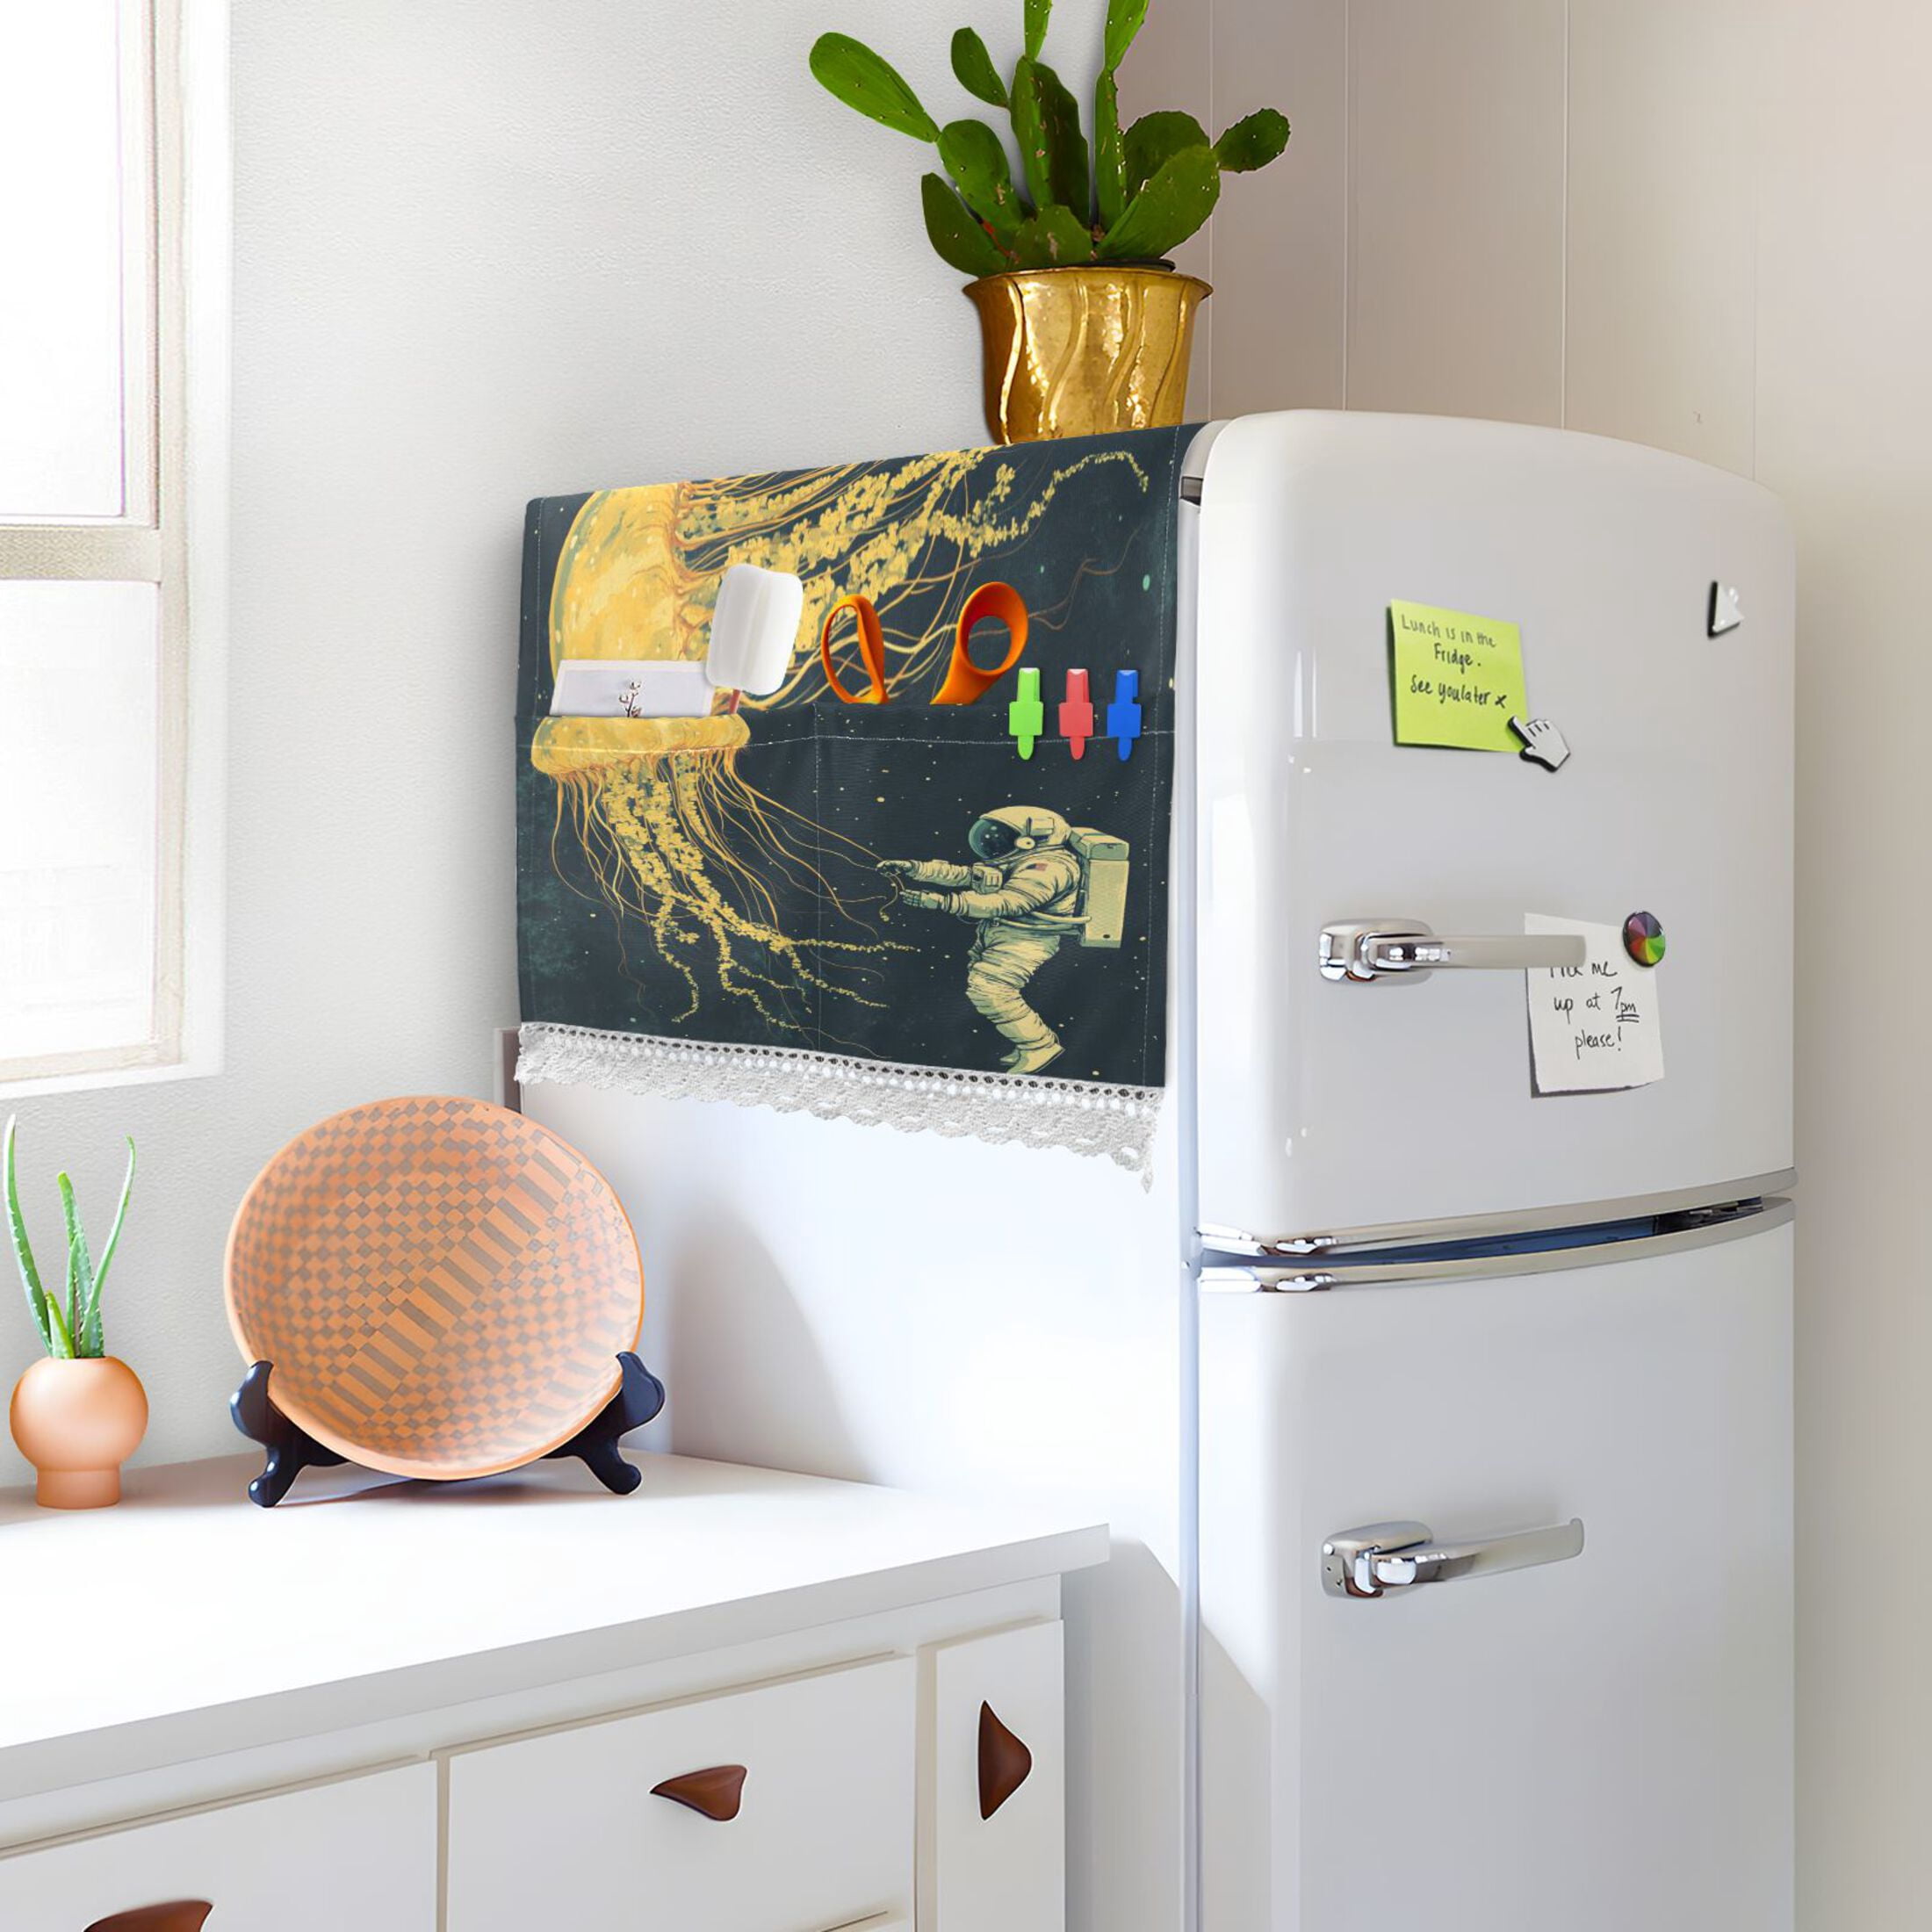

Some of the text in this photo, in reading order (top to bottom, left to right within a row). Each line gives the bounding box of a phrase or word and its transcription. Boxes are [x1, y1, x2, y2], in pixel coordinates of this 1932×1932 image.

[1402, 614, 1440, 638] Lunch
[1460, 631, 1474, 644] in
[1477, 631, 1496, 648] the
[1410, 674, 1433, 695] See
[1591, 961, 1618, 977] me
[1554, 997, 1574, 1025] up
[1586, 991, 1601, 1011] at
[1575, 1026, 1622, 1060] please!
